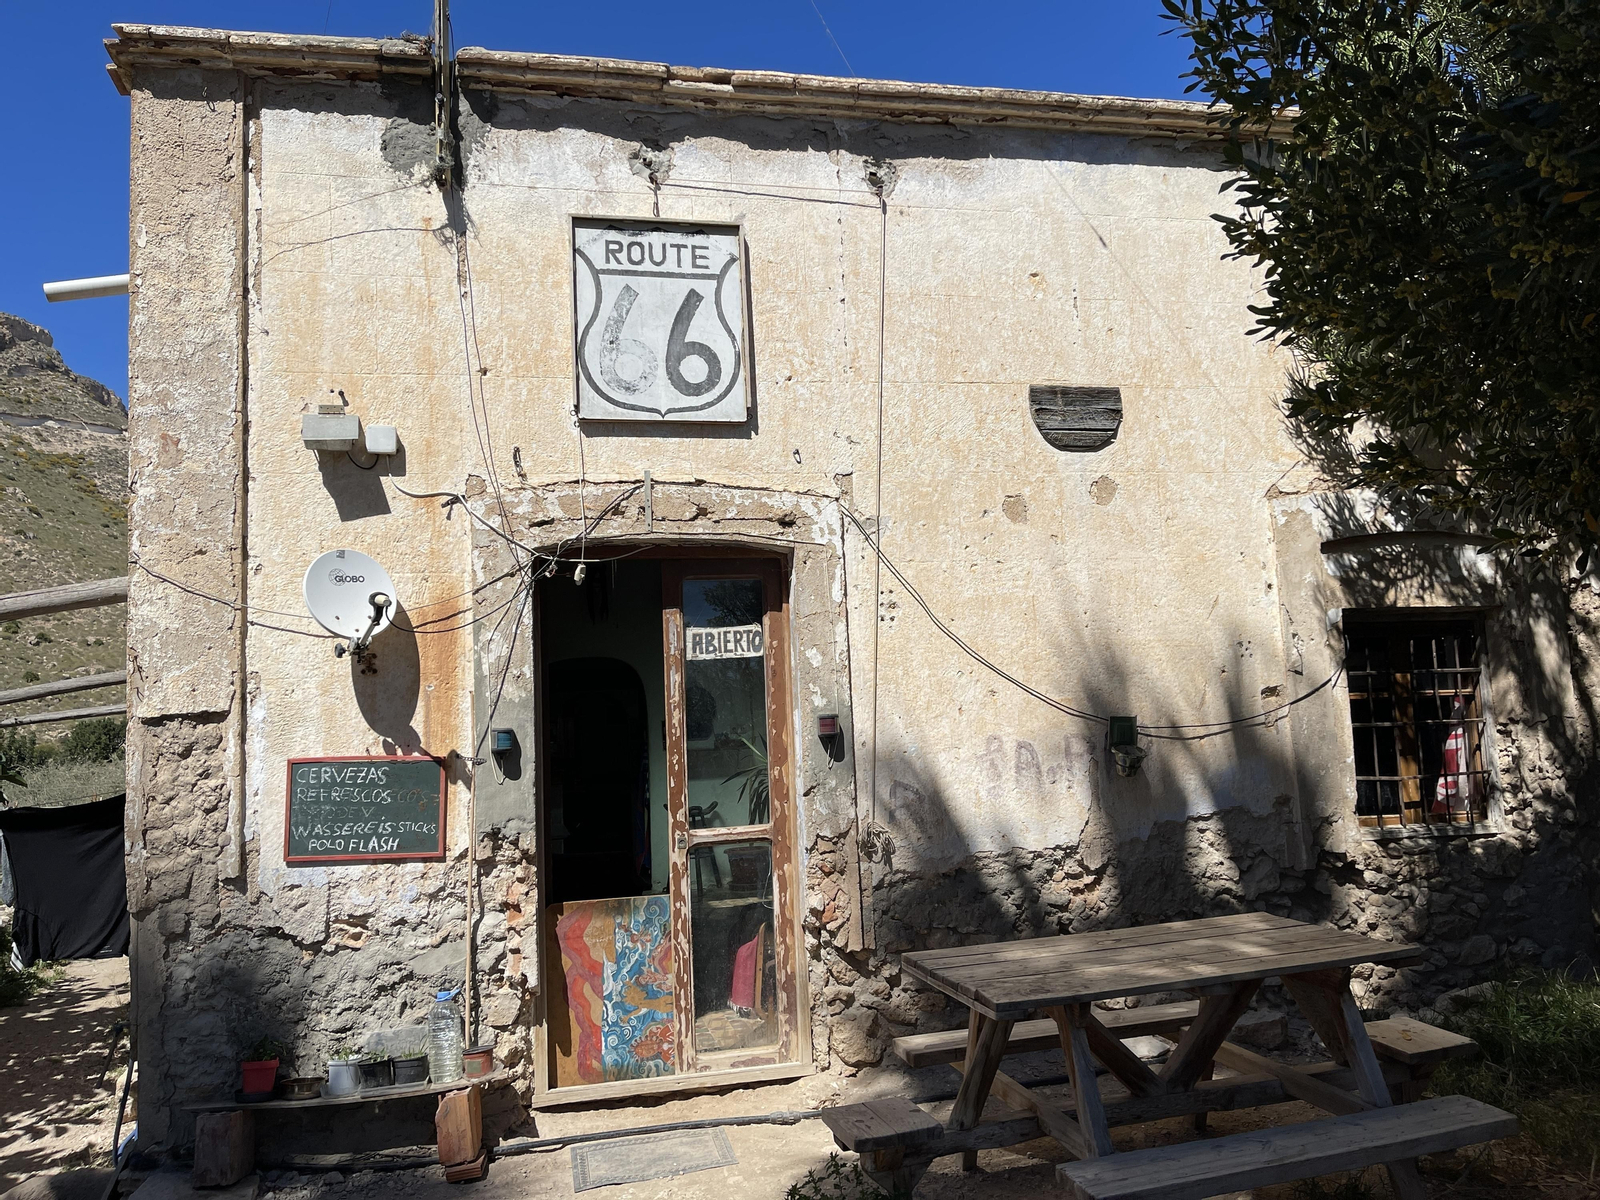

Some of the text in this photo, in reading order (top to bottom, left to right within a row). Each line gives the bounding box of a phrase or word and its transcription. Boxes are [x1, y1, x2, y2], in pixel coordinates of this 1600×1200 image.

[604, 239, 711, 270] ROUTE
[599, 283, 722, 397] 66
[334, 575, 365, 583] GLOBO
[691, 630, 763, 655] ABIERTO
[296, 767, 390, 784] CERVEZAS
[296, 787, 392, 804] REFRESCOS
[398, 821, 436, 835] STICKS
[308, 835, 400, 853] POLO FLASH
